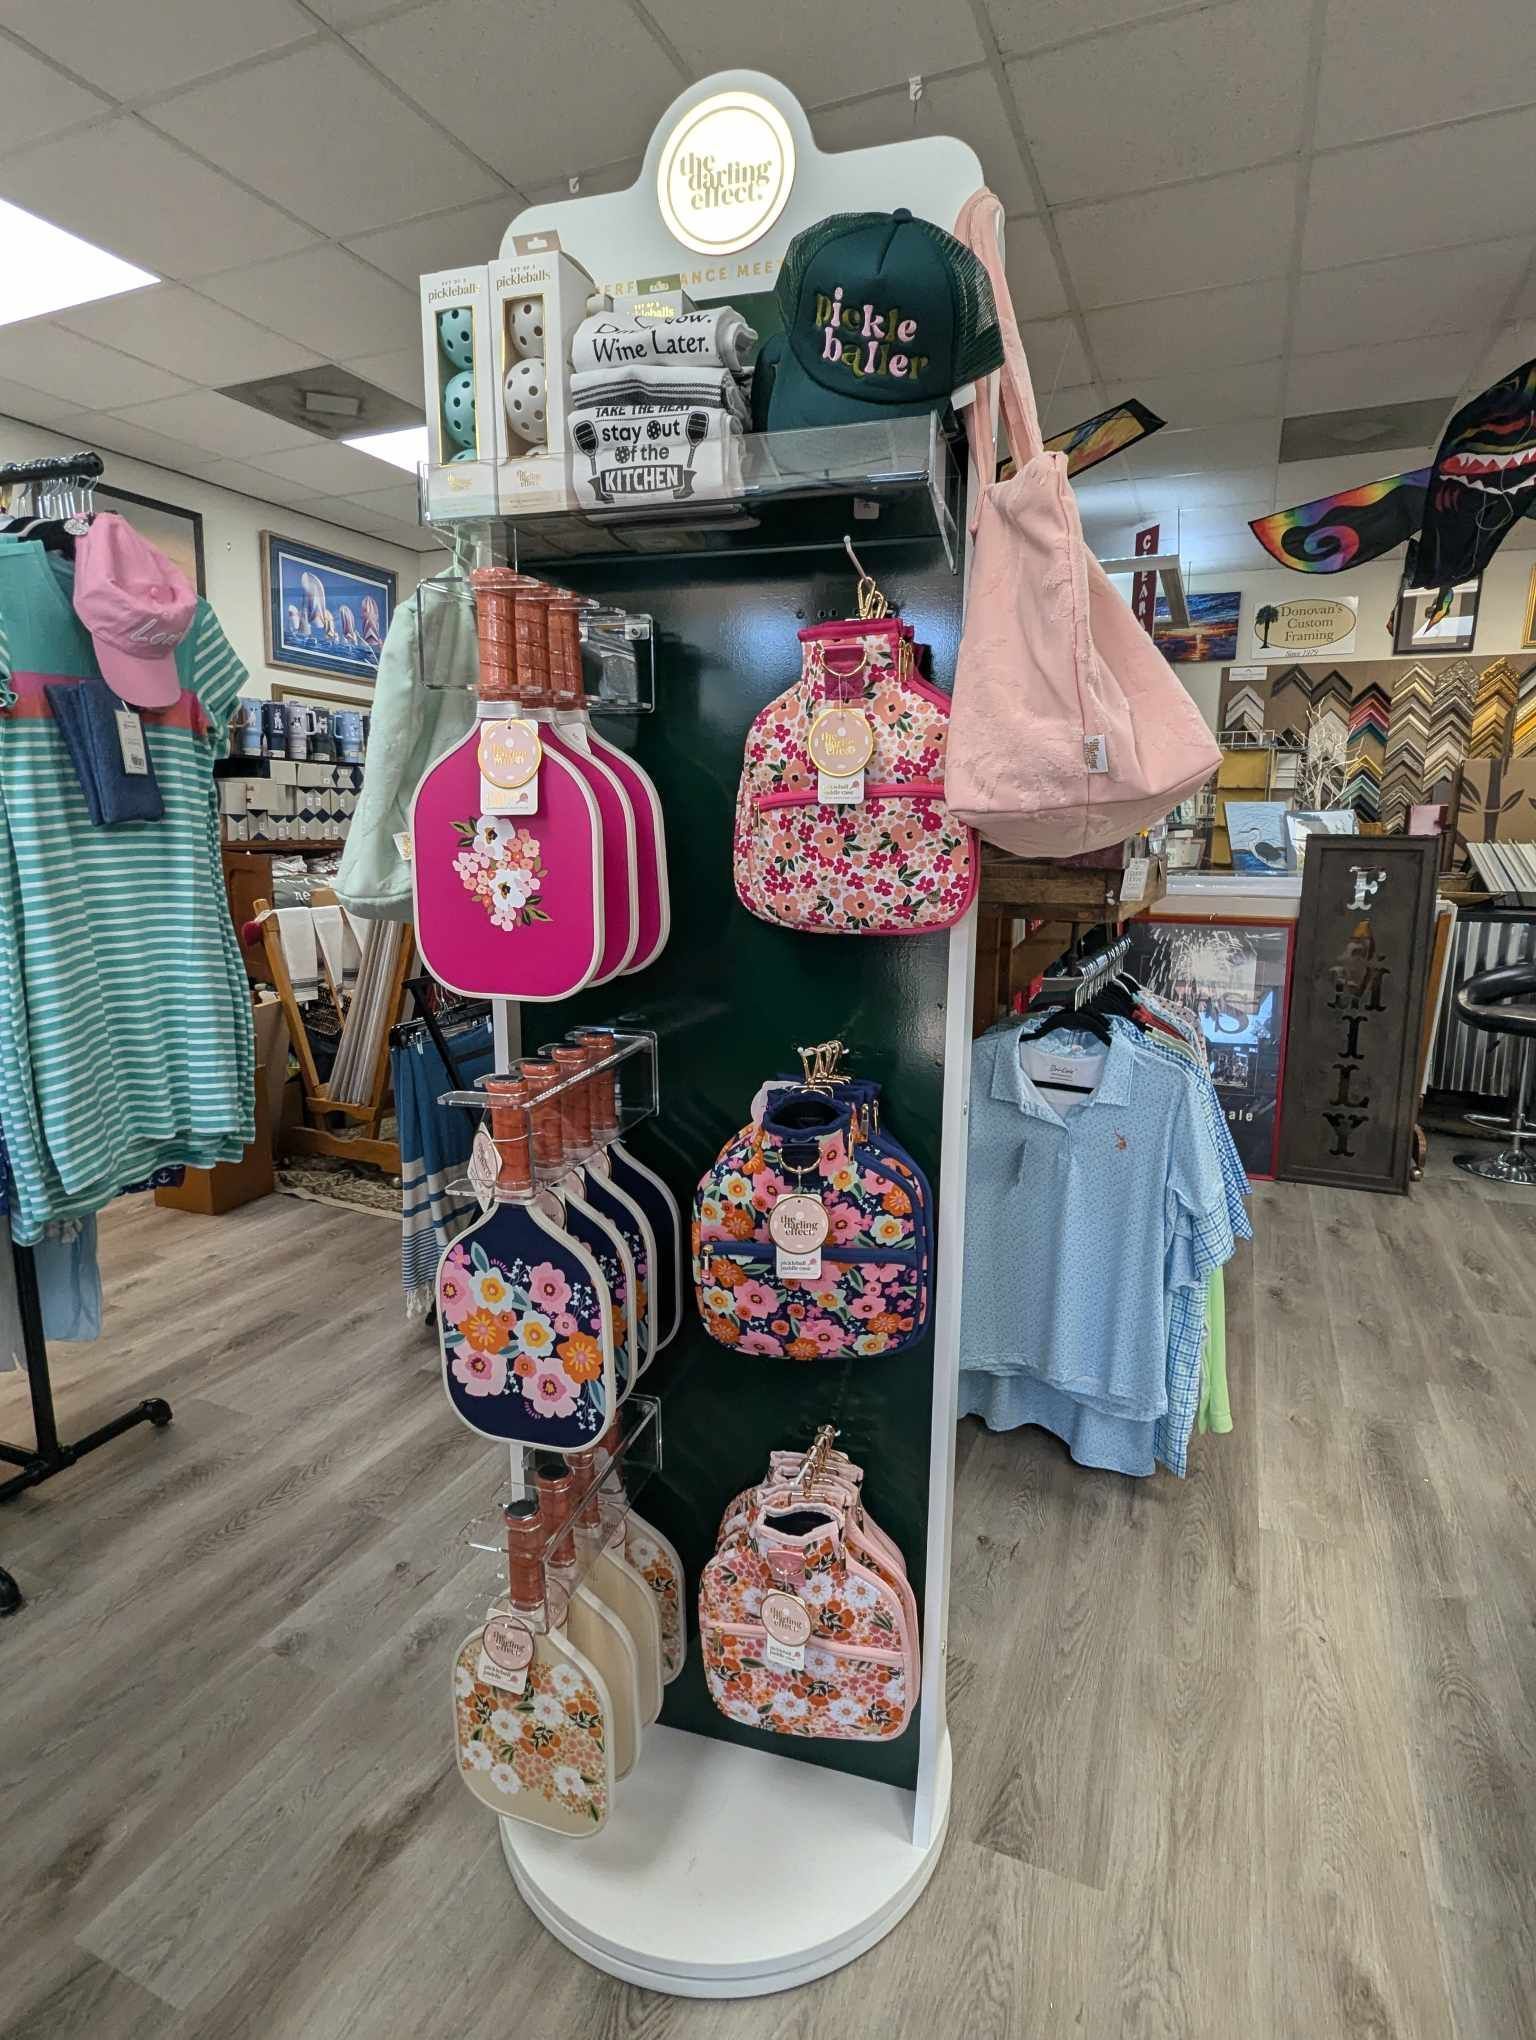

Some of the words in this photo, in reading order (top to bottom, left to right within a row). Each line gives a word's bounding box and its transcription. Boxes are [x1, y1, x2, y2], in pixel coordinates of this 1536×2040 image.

[680, 152, 715, 176] the
[688, 160, 772, 191] darling
[496, 269, 551, 290] pickleballs
[428, 283, 480, 304] pickleballs
[816, 287, 917, 342] pickle
[592, 336, 648, 364] Wine
[651, 329, 709, 355] Later.
[822, 326, 929, 380] baller
[595, 406, 626, 418] TAKE
[631, 404, 655, 415] THE
[602, 424, 642, 444] stay
[641, 444, 670, 463] the
[605, 466, 679, 492] KITCHEN
[1281, 604, 1343, 617] Donovan's
[1287, 618, 1334, 629] Custom
[1284, 630, 1334, 641] Framing
[780, 1214, 796, 1223] the
